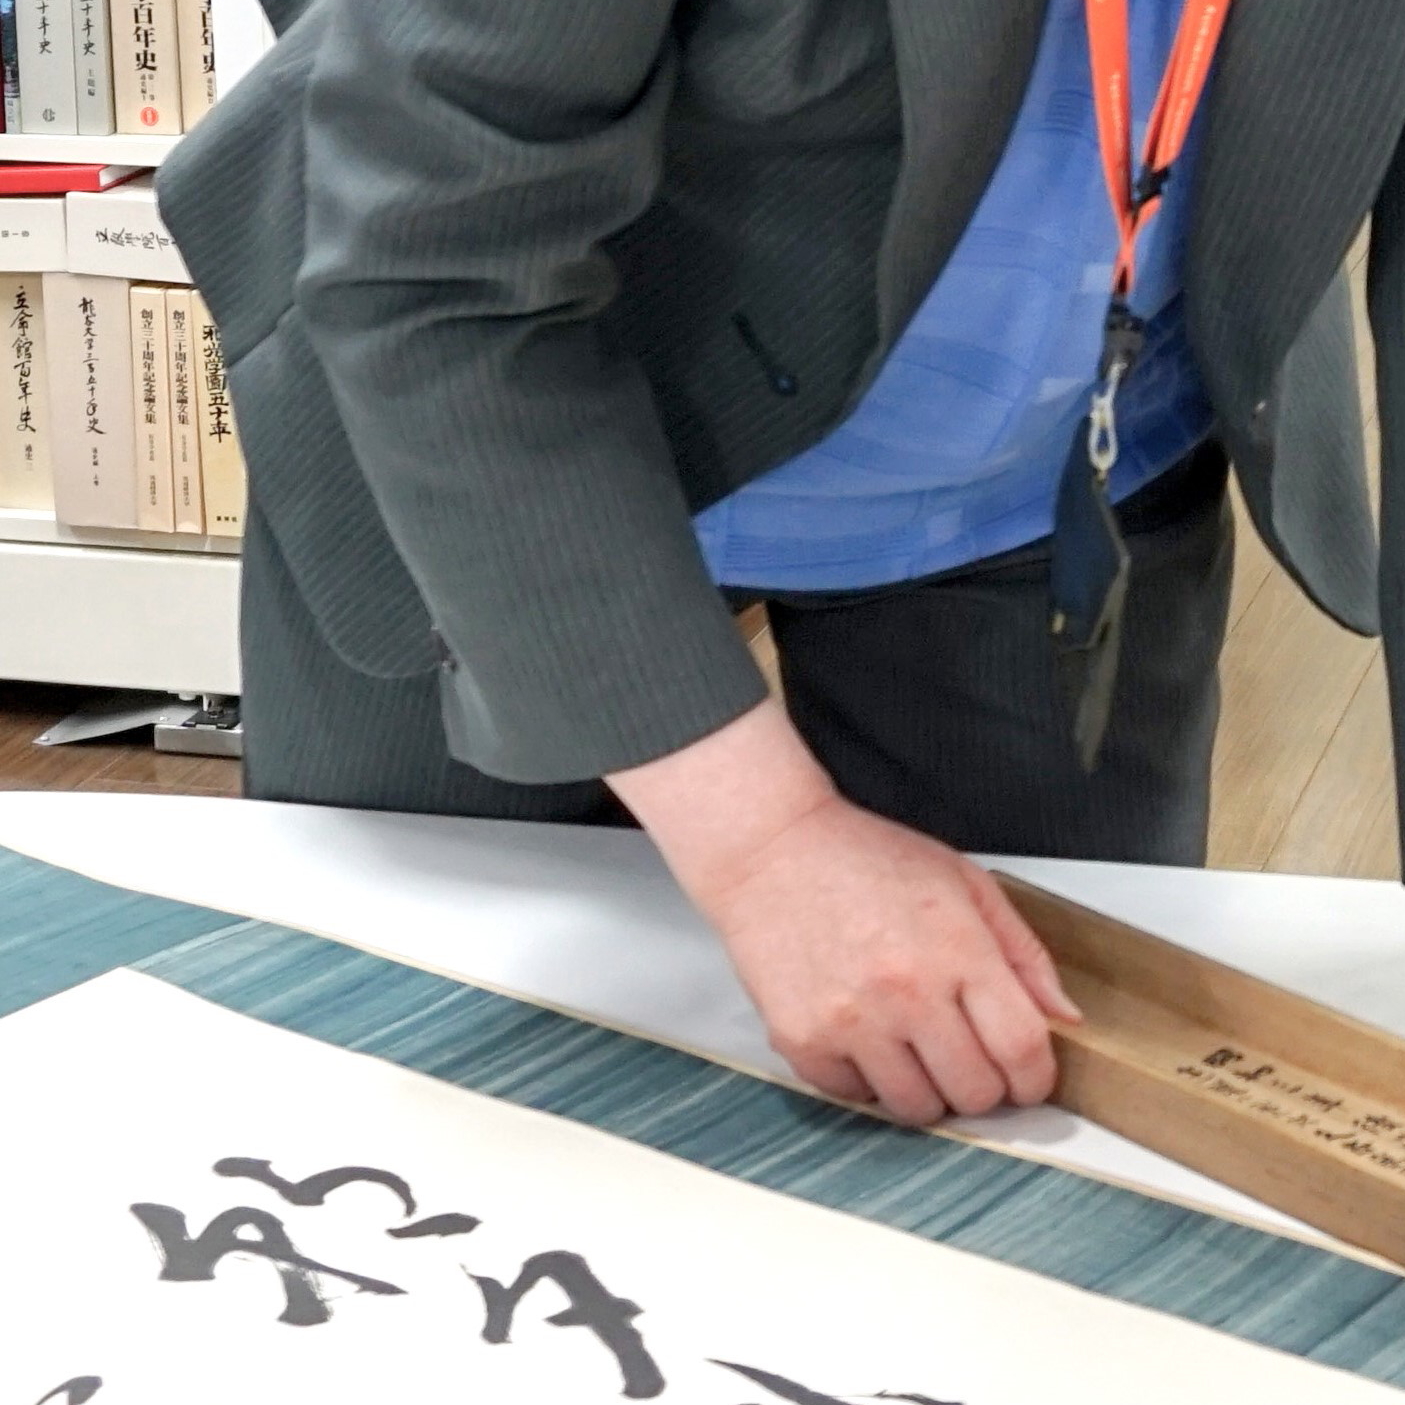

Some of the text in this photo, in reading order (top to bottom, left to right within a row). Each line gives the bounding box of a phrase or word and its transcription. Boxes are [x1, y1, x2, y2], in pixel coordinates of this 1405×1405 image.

[9, 286, 36, 434] 立命館百年史
[141, 308, 157, 425] 創立三十周年記念論文集
[172, 309, 189, 425] 創立三十周年記念論文集
